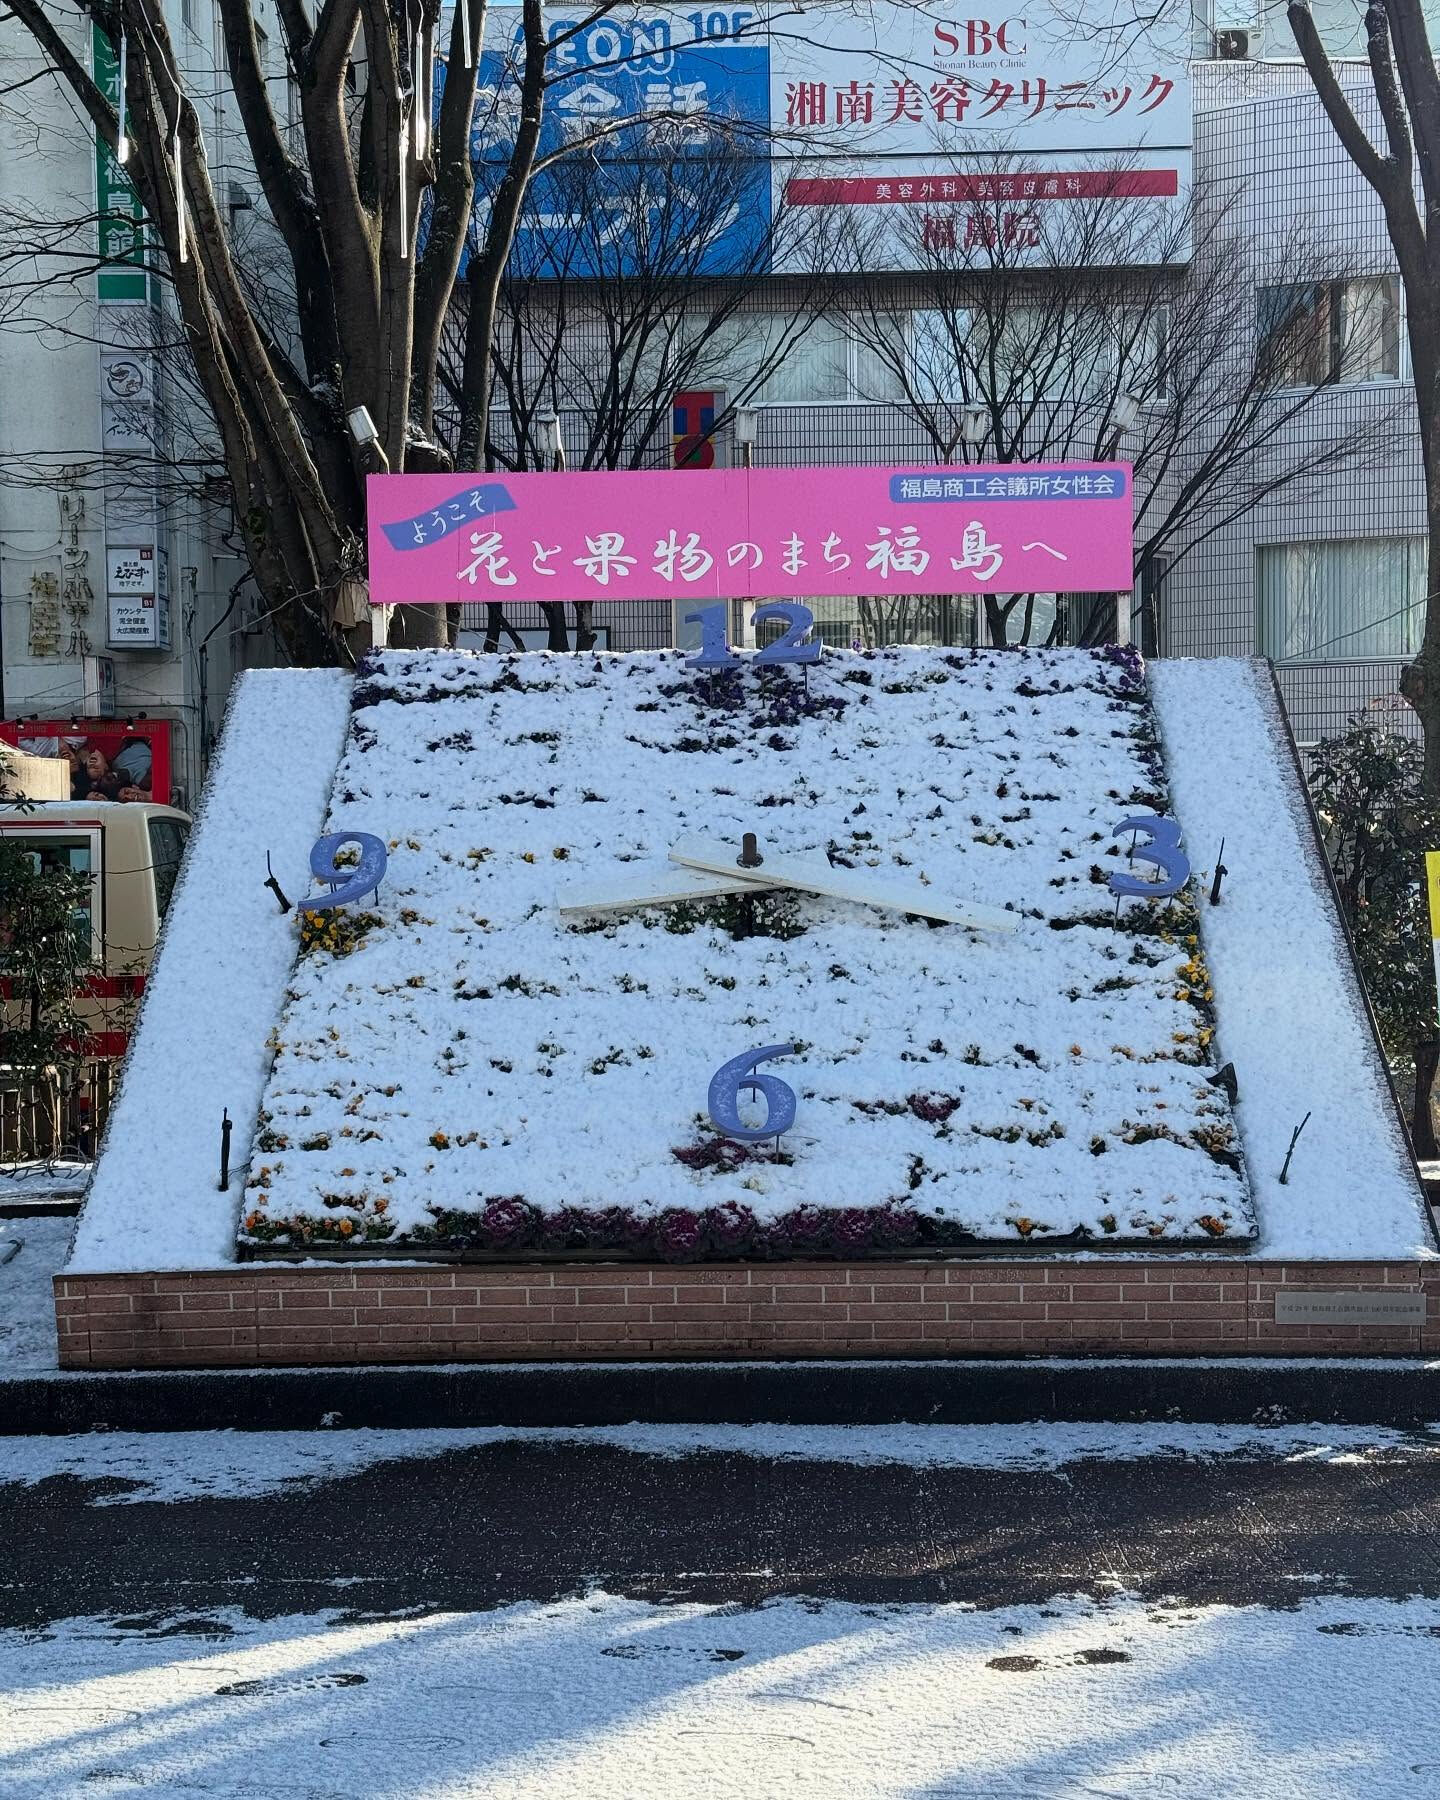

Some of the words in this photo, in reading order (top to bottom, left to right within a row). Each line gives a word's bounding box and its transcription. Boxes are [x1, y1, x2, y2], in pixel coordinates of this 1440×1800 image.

[689, 11, 752, 44] 10F
[933, 18, 1027, 57] SBC
[933, 60, 966, 70] Shonan
[968, 59, 998, 70] Beauty
[1000, 58, 1027, 68] Clinic
[785, 74, 1175, 127] 湘南美容クリニック
[922, 212, 1041, 250] 福島院
[900, 474, 1115, 499] 福島商工会議所女性会
[411, 490, 487, 544] ようこそ
[141, 551, 152, 559] B1
[456, 520, 1068, 586] 花と果物のまち福島へ
[115, 607, 149, 615] カウンター
[685, 602, 823, 668] 12
[298, 831, 388, 909] 9
[1110, 816, 1191, 897] 3
[708, 1044, 797, 1141] 6
